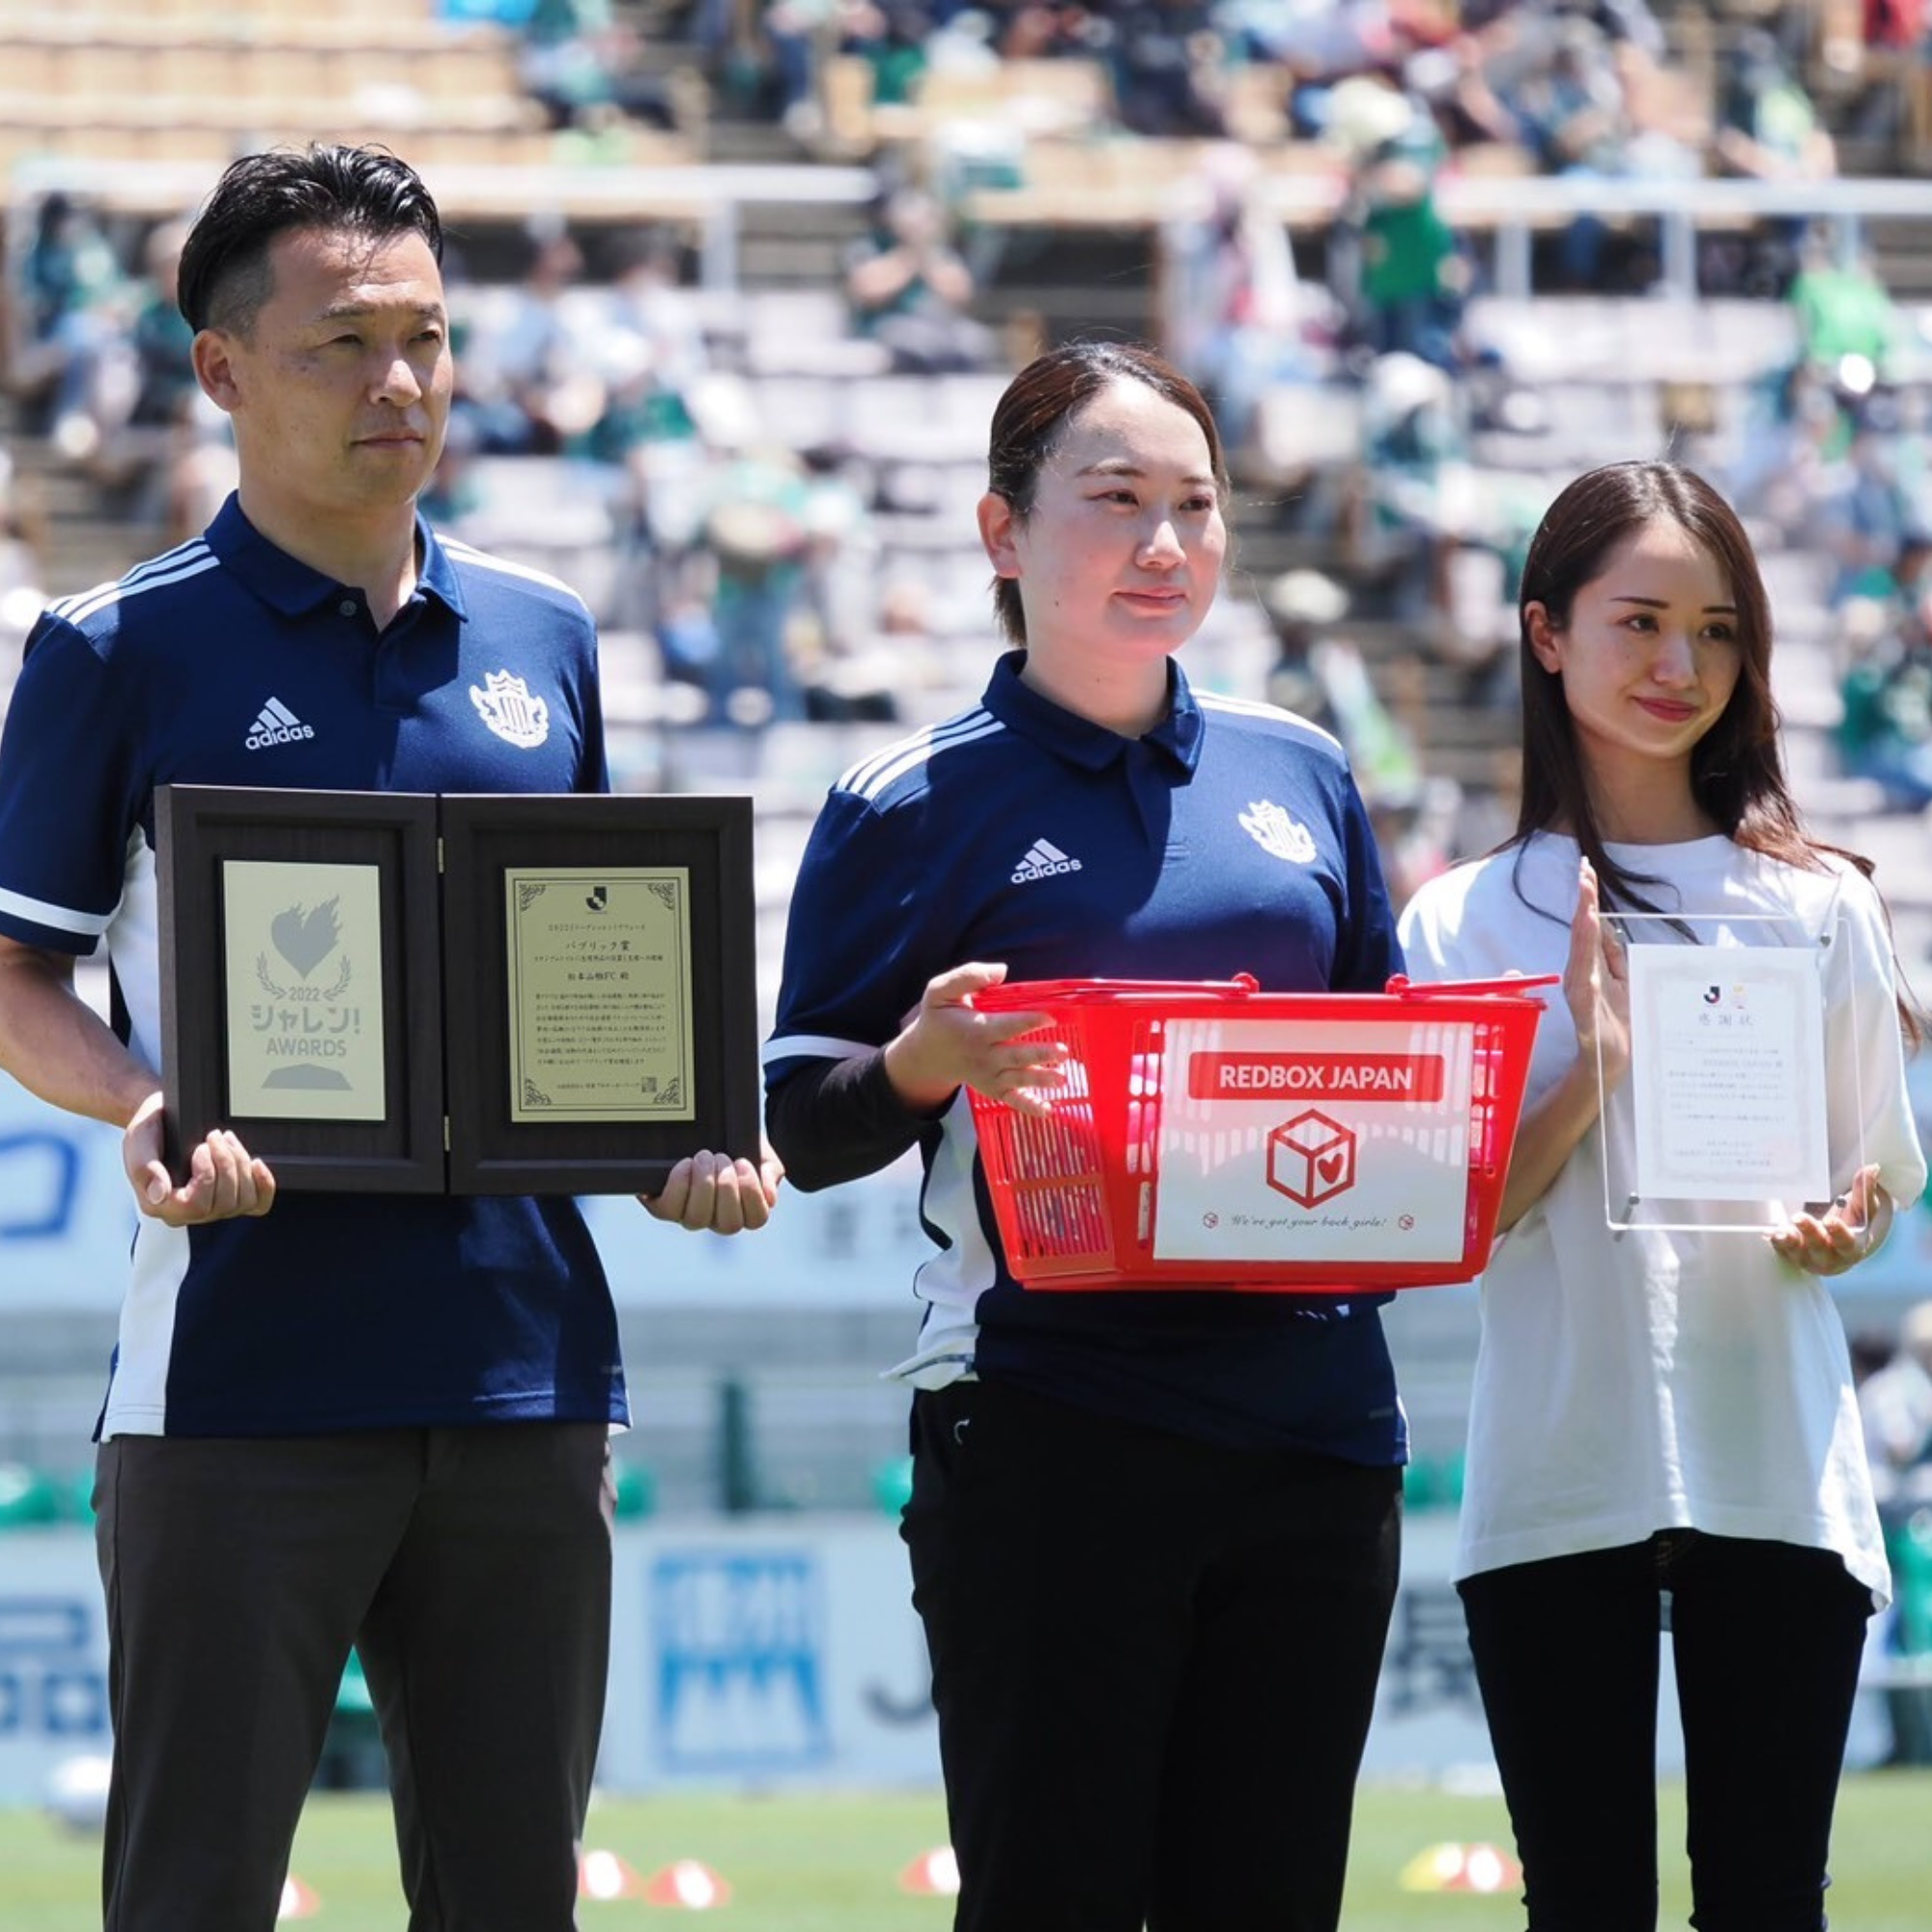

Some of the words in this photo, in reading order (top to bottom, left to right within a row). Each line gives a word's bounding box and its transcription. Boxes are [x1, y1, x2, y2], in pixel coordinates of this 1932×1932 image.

[245, 724, 314, 750] adidas
[1011, 858, 1083, 884] adidas
[289, 986, 320, 1002] 2022
[266, 1037, 347, 1057] AWARDS
[1219, 1065, 1324, 1090] REDBOX
[1328, 1066, 1413, 1091] JAPAN
[1264, 1217, 1289, 1230] got
[1287, 1219, 1318, 1230] your
[1321, 1216, 1350, 1227] back
